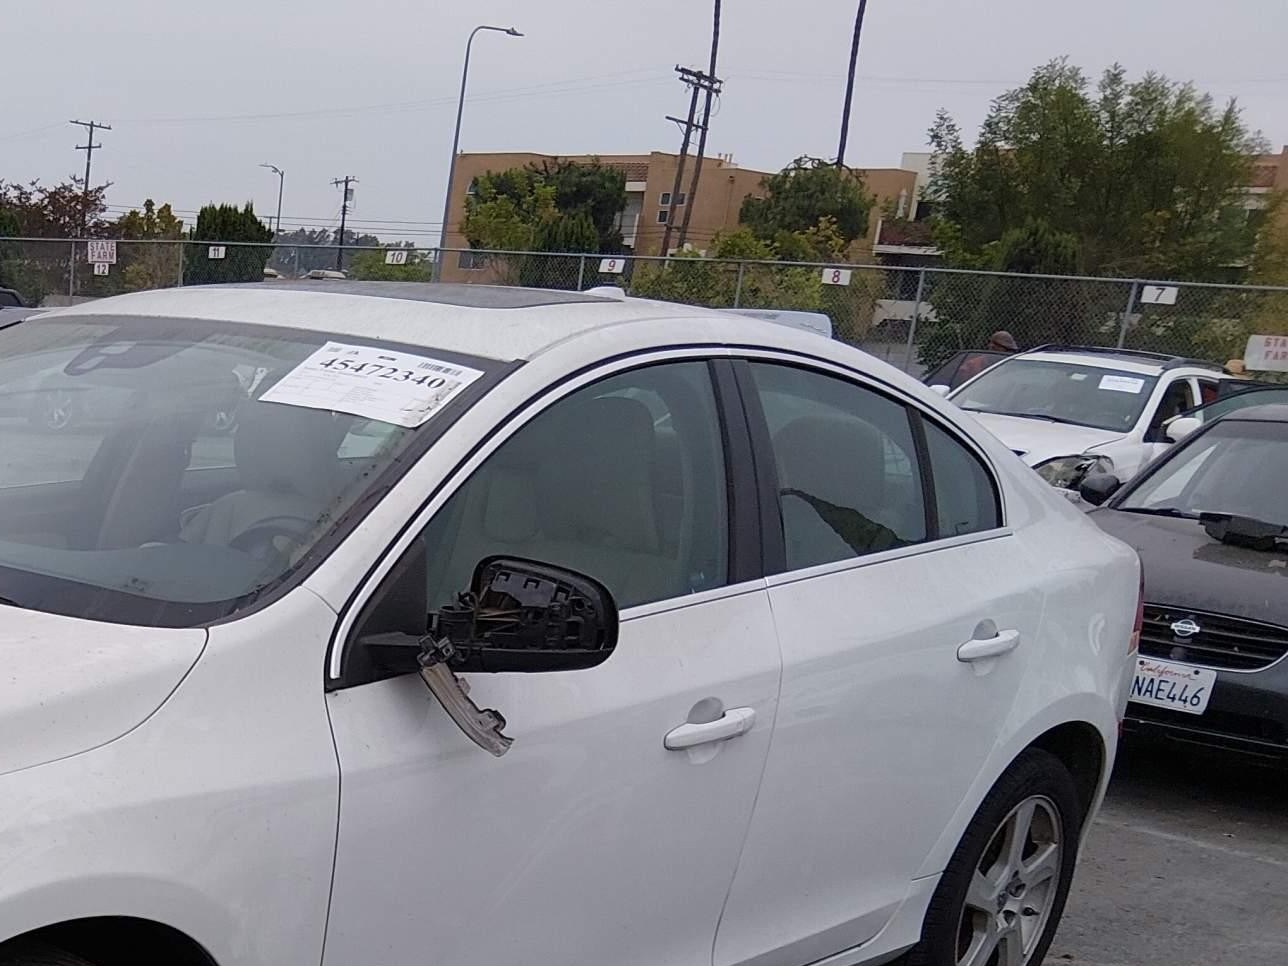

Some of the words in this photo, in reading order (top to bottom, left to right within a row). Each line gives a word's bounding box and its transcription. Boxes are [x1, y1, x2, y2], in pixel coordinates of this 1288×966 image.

[90, 242, 114, 251] STATE
[91, 251, 114, 260] FARM
[391, 252, 403, 263] 10
[97, 264, 107, 274] 12
[607, 260, 616, 271] 9
[832, 270, 841, 283] 8
[1154, 287, 1166, 302] 7
[320, 357, 446, 389] 45472340
[1131, 675, 1205, 706] NAE446
